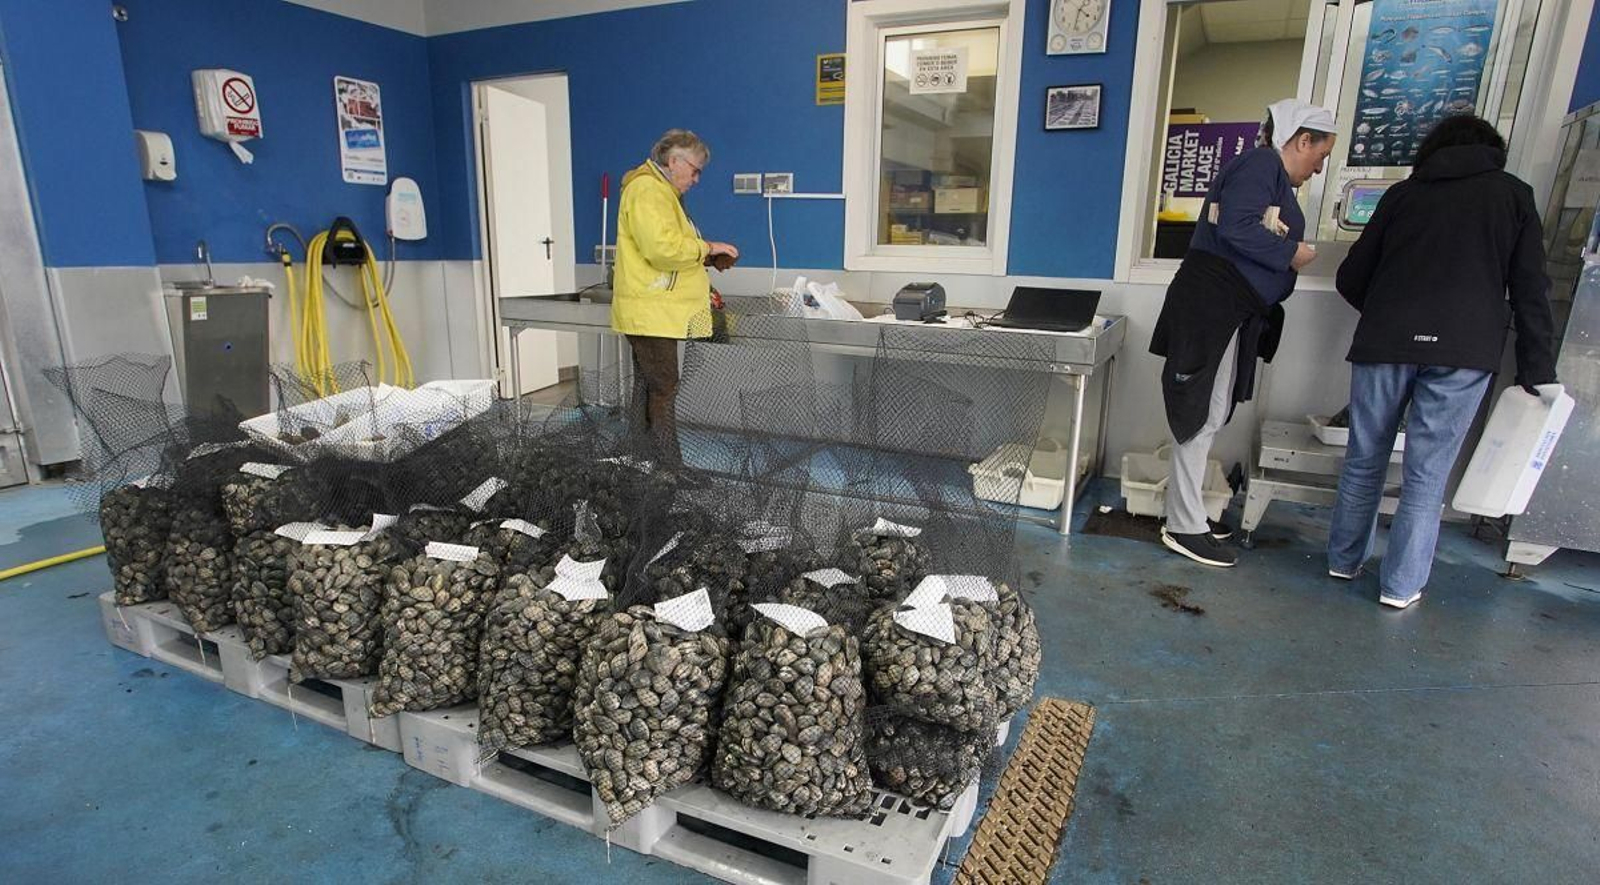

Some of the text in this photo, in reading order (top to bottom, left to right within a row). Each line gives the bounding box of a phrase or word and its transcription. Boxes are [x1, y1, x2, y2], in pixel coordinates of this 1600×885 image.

[1163, 134, 1184, 193] GALICIA
[1179, 129, 1200, 192] MARKET
[1194, 144, 1215, 192] PLACE
